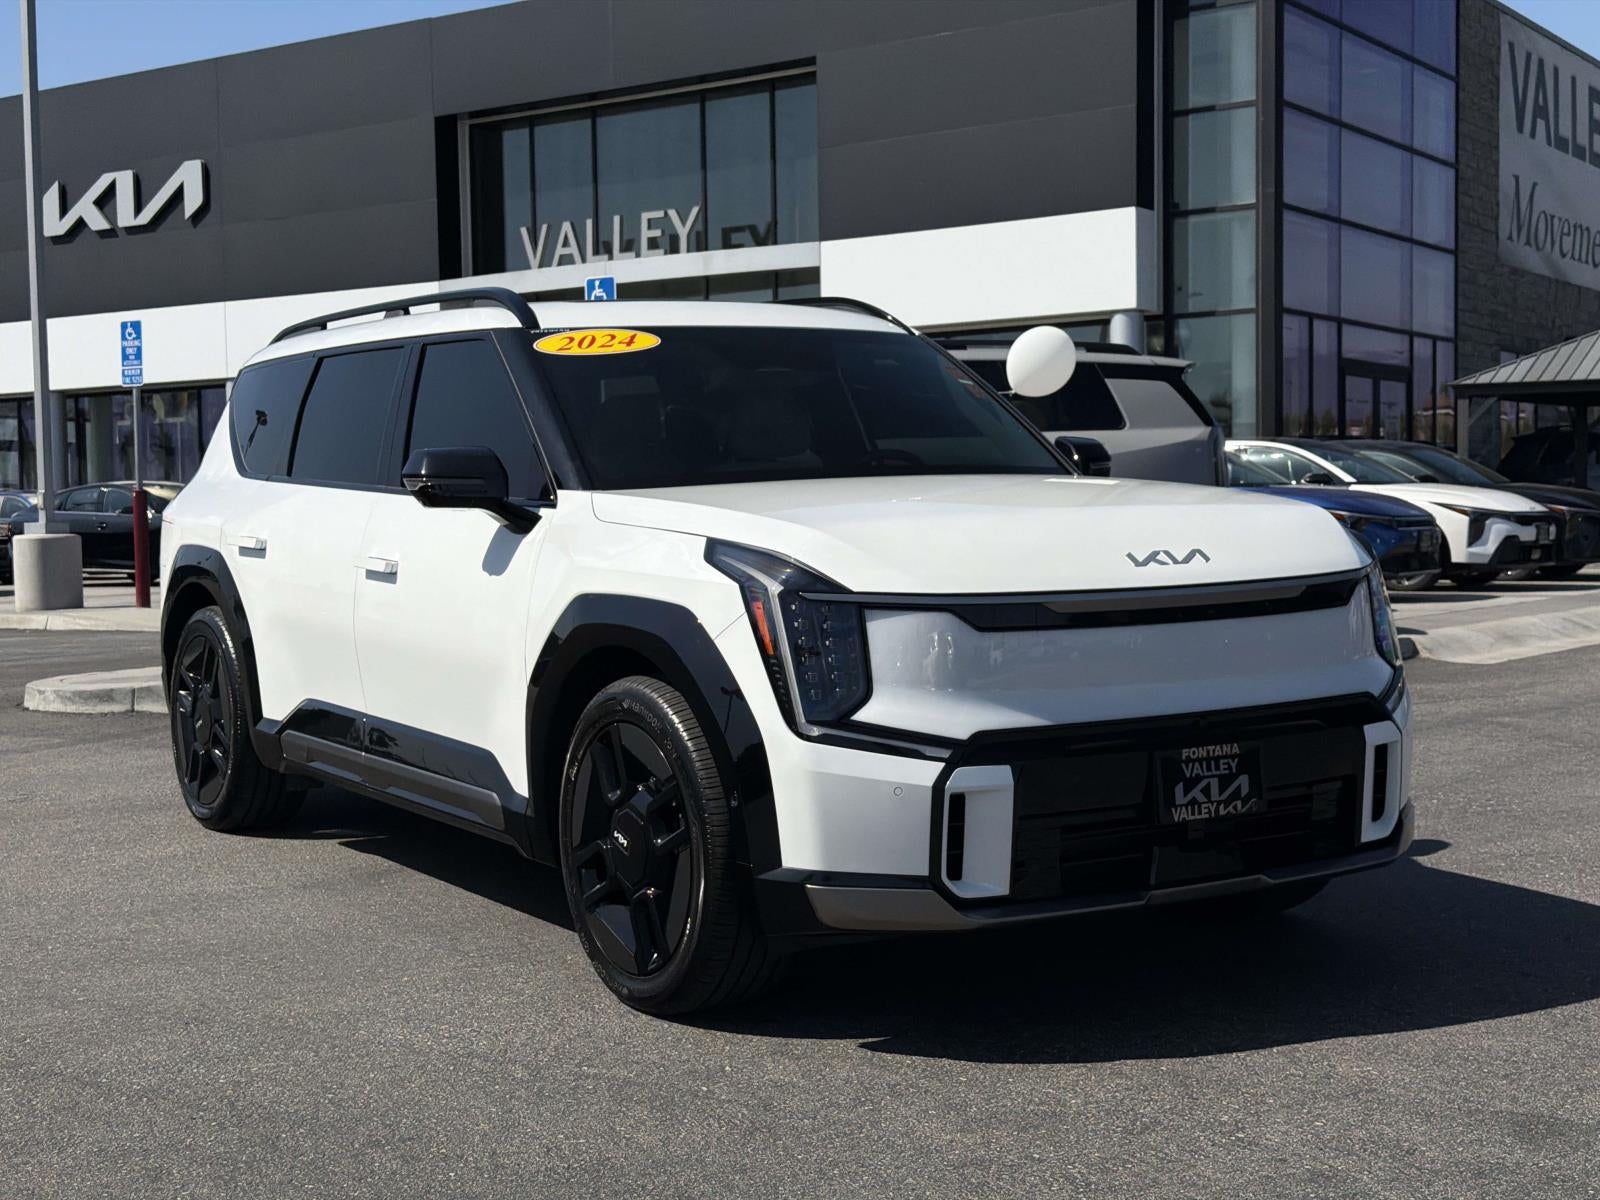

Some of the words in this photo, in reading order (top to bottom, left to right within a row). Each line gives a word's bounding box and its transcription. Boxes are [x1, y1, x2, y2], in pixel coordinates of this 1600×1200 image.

[42, 158, 204, 238] KIA
[520, 205, 700, 270] VALLEY
[556, 333, 638, 352] 2024
[1181, 743, 1240, 760] FONTANA
[1181, 758, 1239, 779] VALLEY
[1174, 774, 1250, 806] KIA
[1171, 803, 1218, 823] VALLEY
